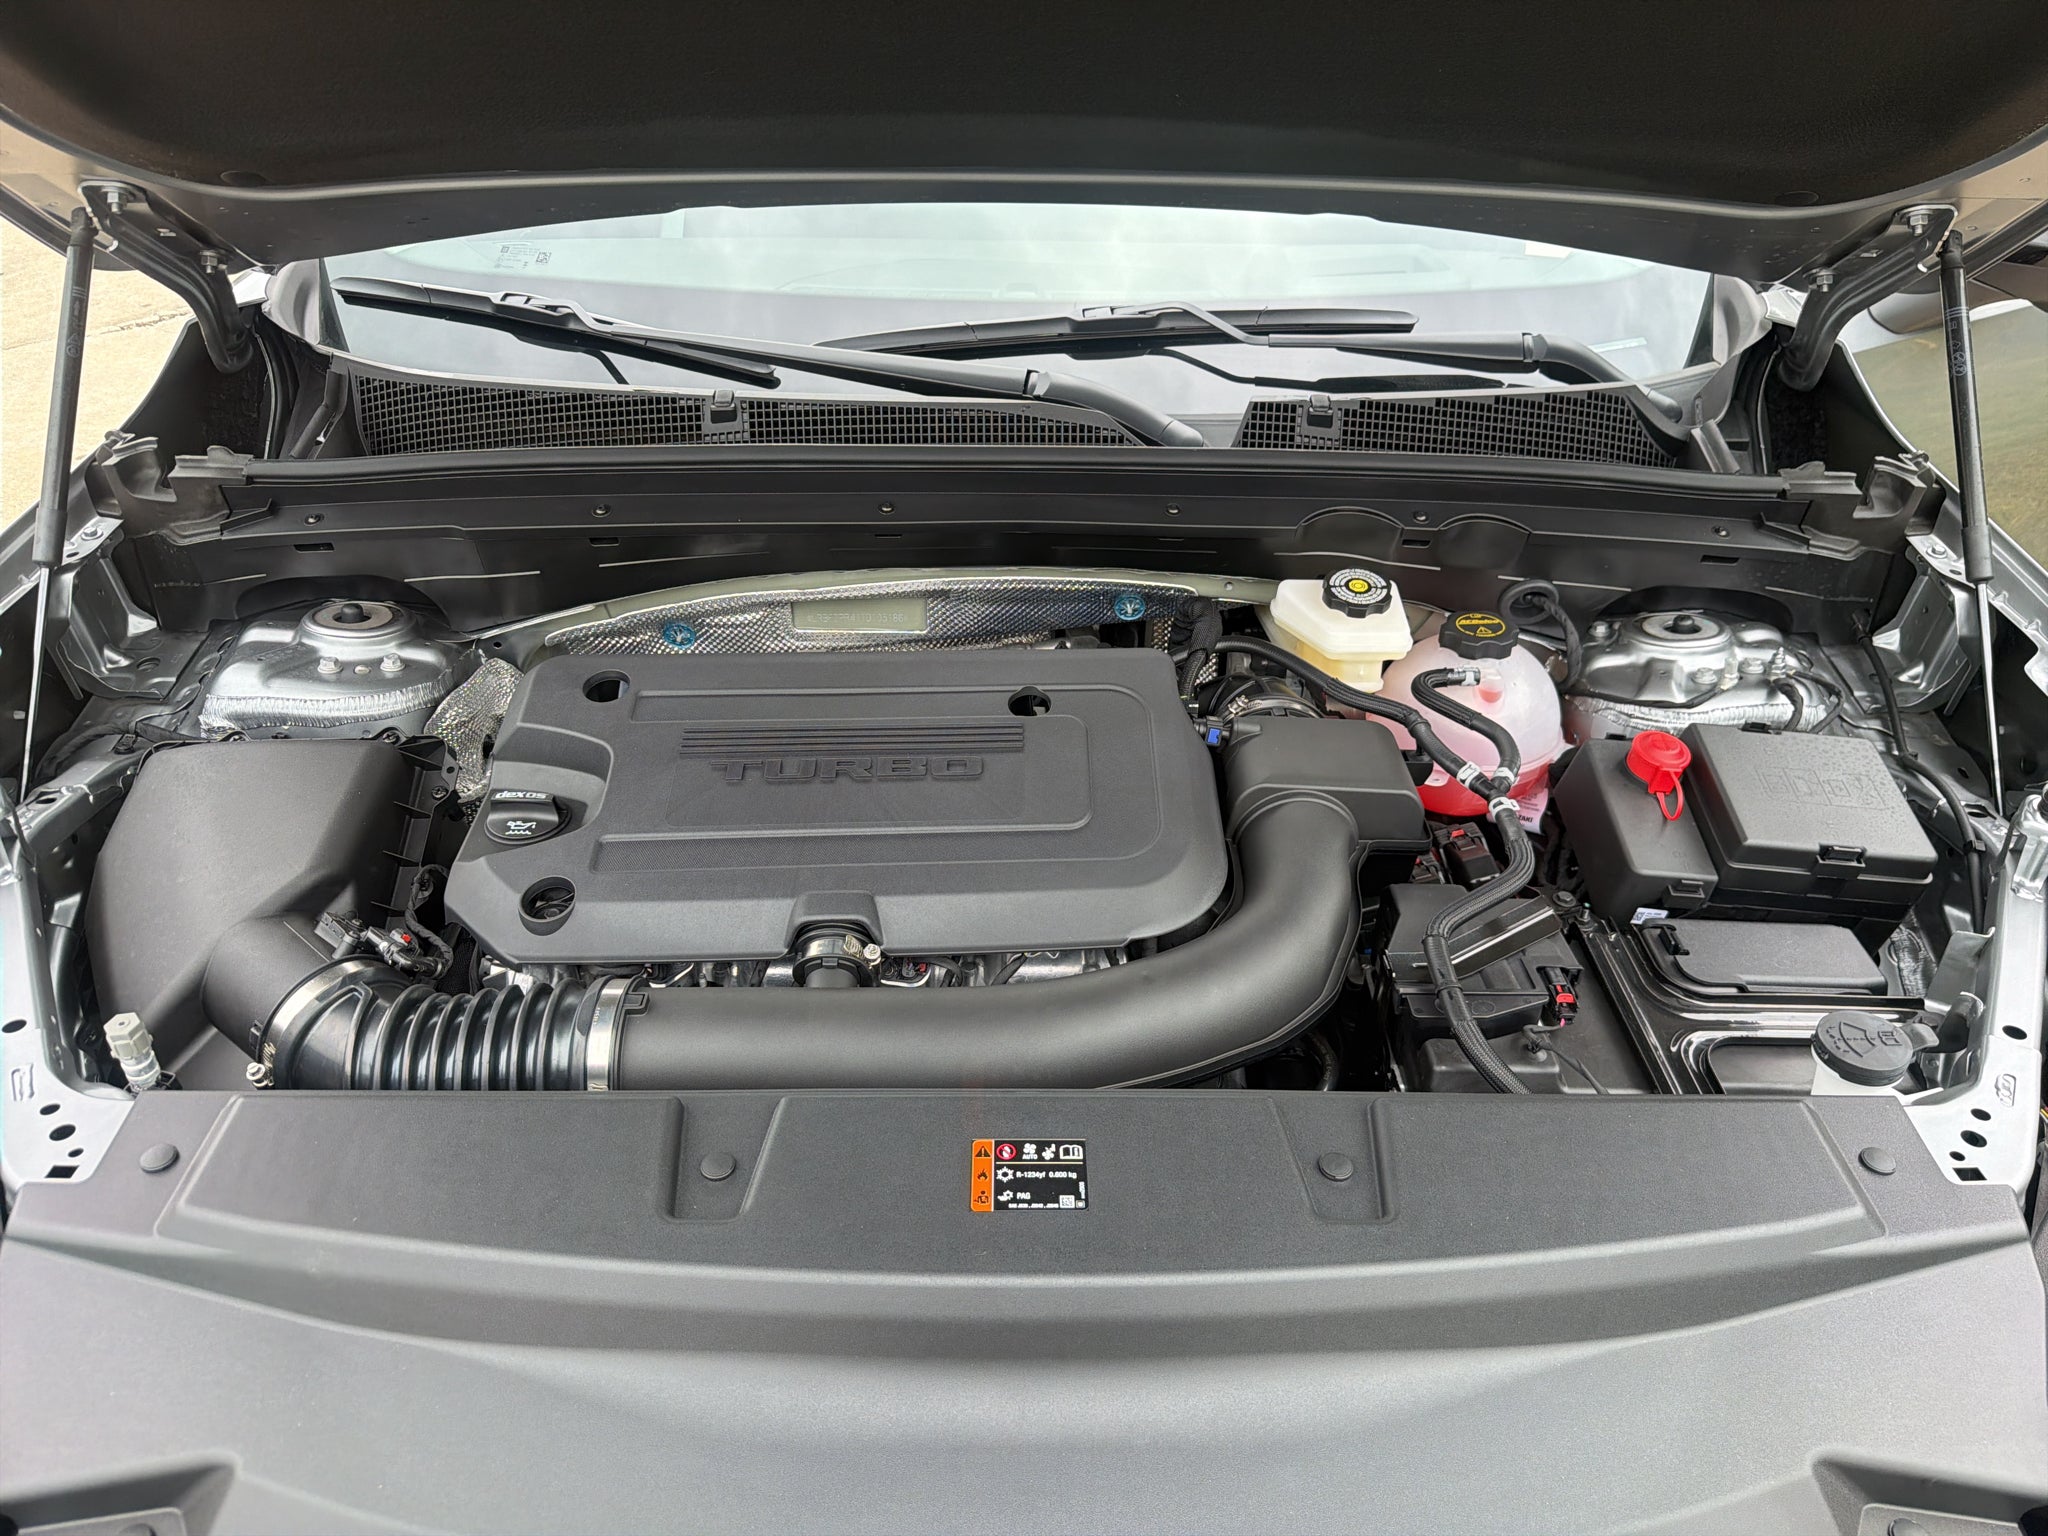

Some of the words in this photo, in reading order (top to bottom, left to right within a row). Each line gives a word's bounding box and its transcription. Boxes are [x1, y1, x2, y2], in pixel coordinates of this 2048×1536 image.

[710, 756, 984, 783] TURBO
[495, 790, 550, 799] dexos
[1016, 1171, 1046, 1179] R-1234yf
[1068, 1171, 1078, 1179] kg
[1016, 1192, 1031, 1200] PAG
